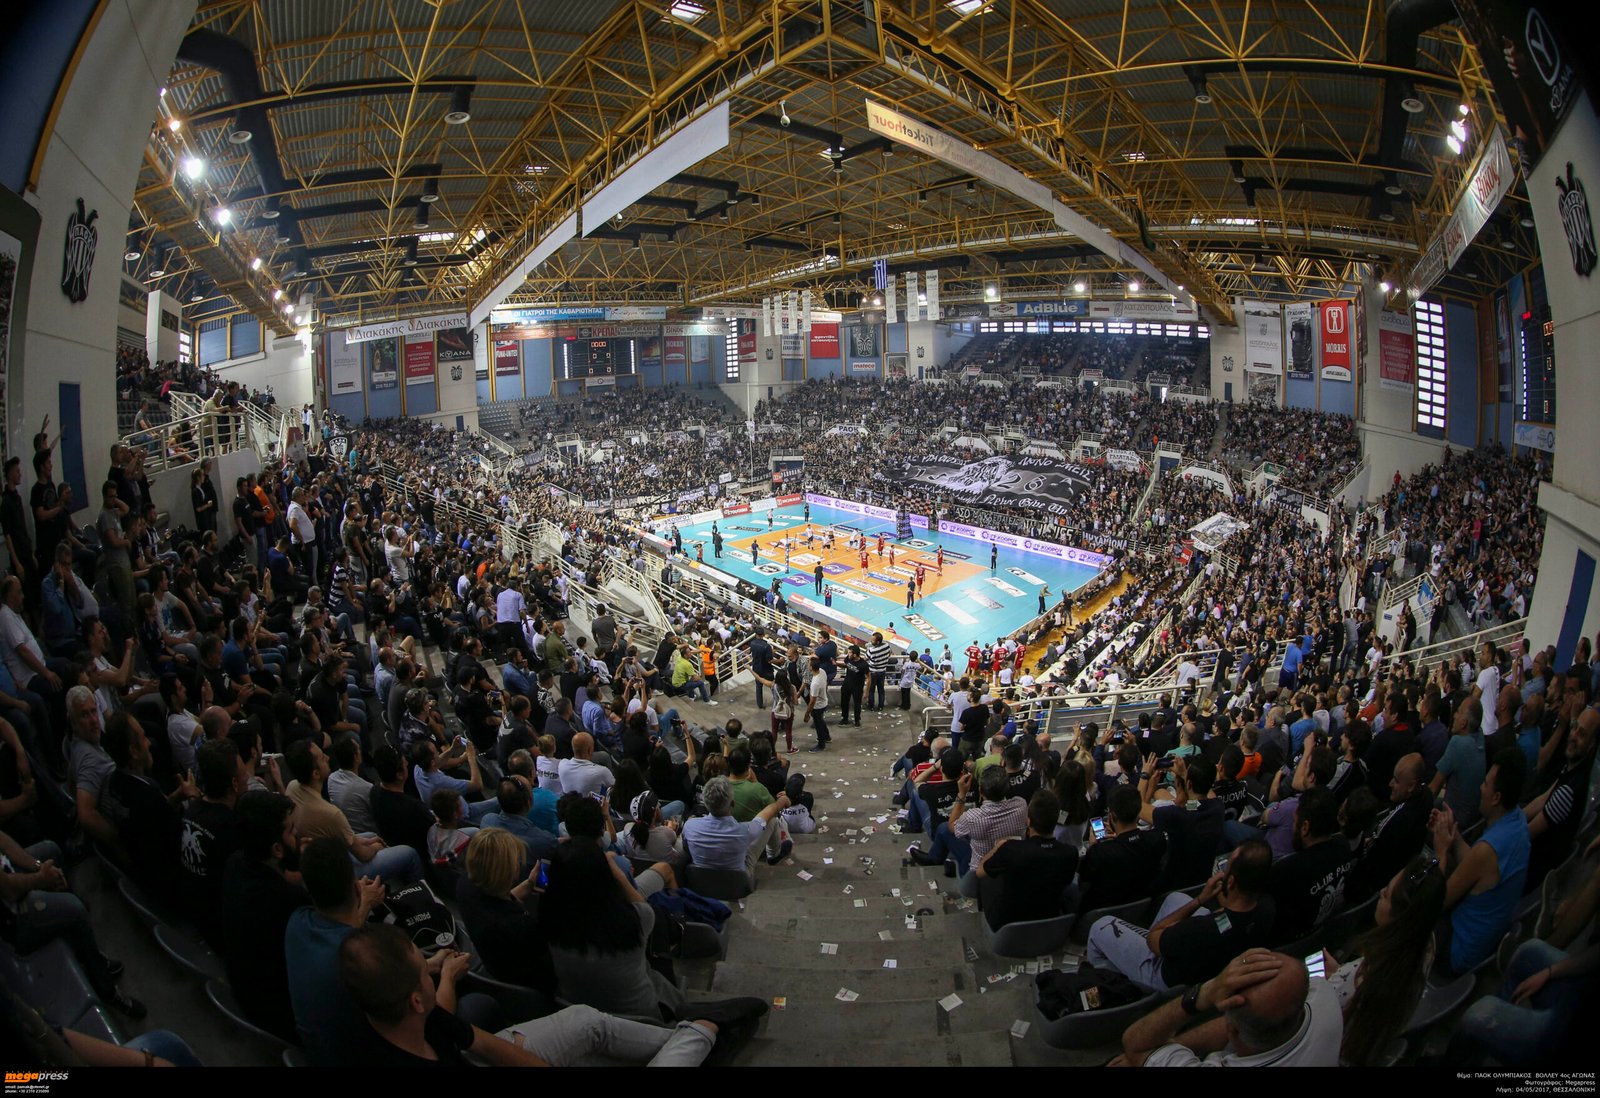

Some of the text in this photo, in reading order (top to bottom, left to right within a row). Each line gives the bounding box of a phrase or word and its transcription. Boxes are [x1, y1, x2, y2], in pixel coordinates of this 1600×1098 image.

[522, 309, 545, 317] ΓΙΑΤΡΟΙ
[558, 307, 603, 315] ΚΑΘΑΡΙΟΤΗΤΑΣ
[1023, 303, 1079, 314] AdBlue
[416, 317, 466, 331] Διακάκης
[355, 324, 404, 340] Διακάκης
[905, 613, 944, 641] FORZA
